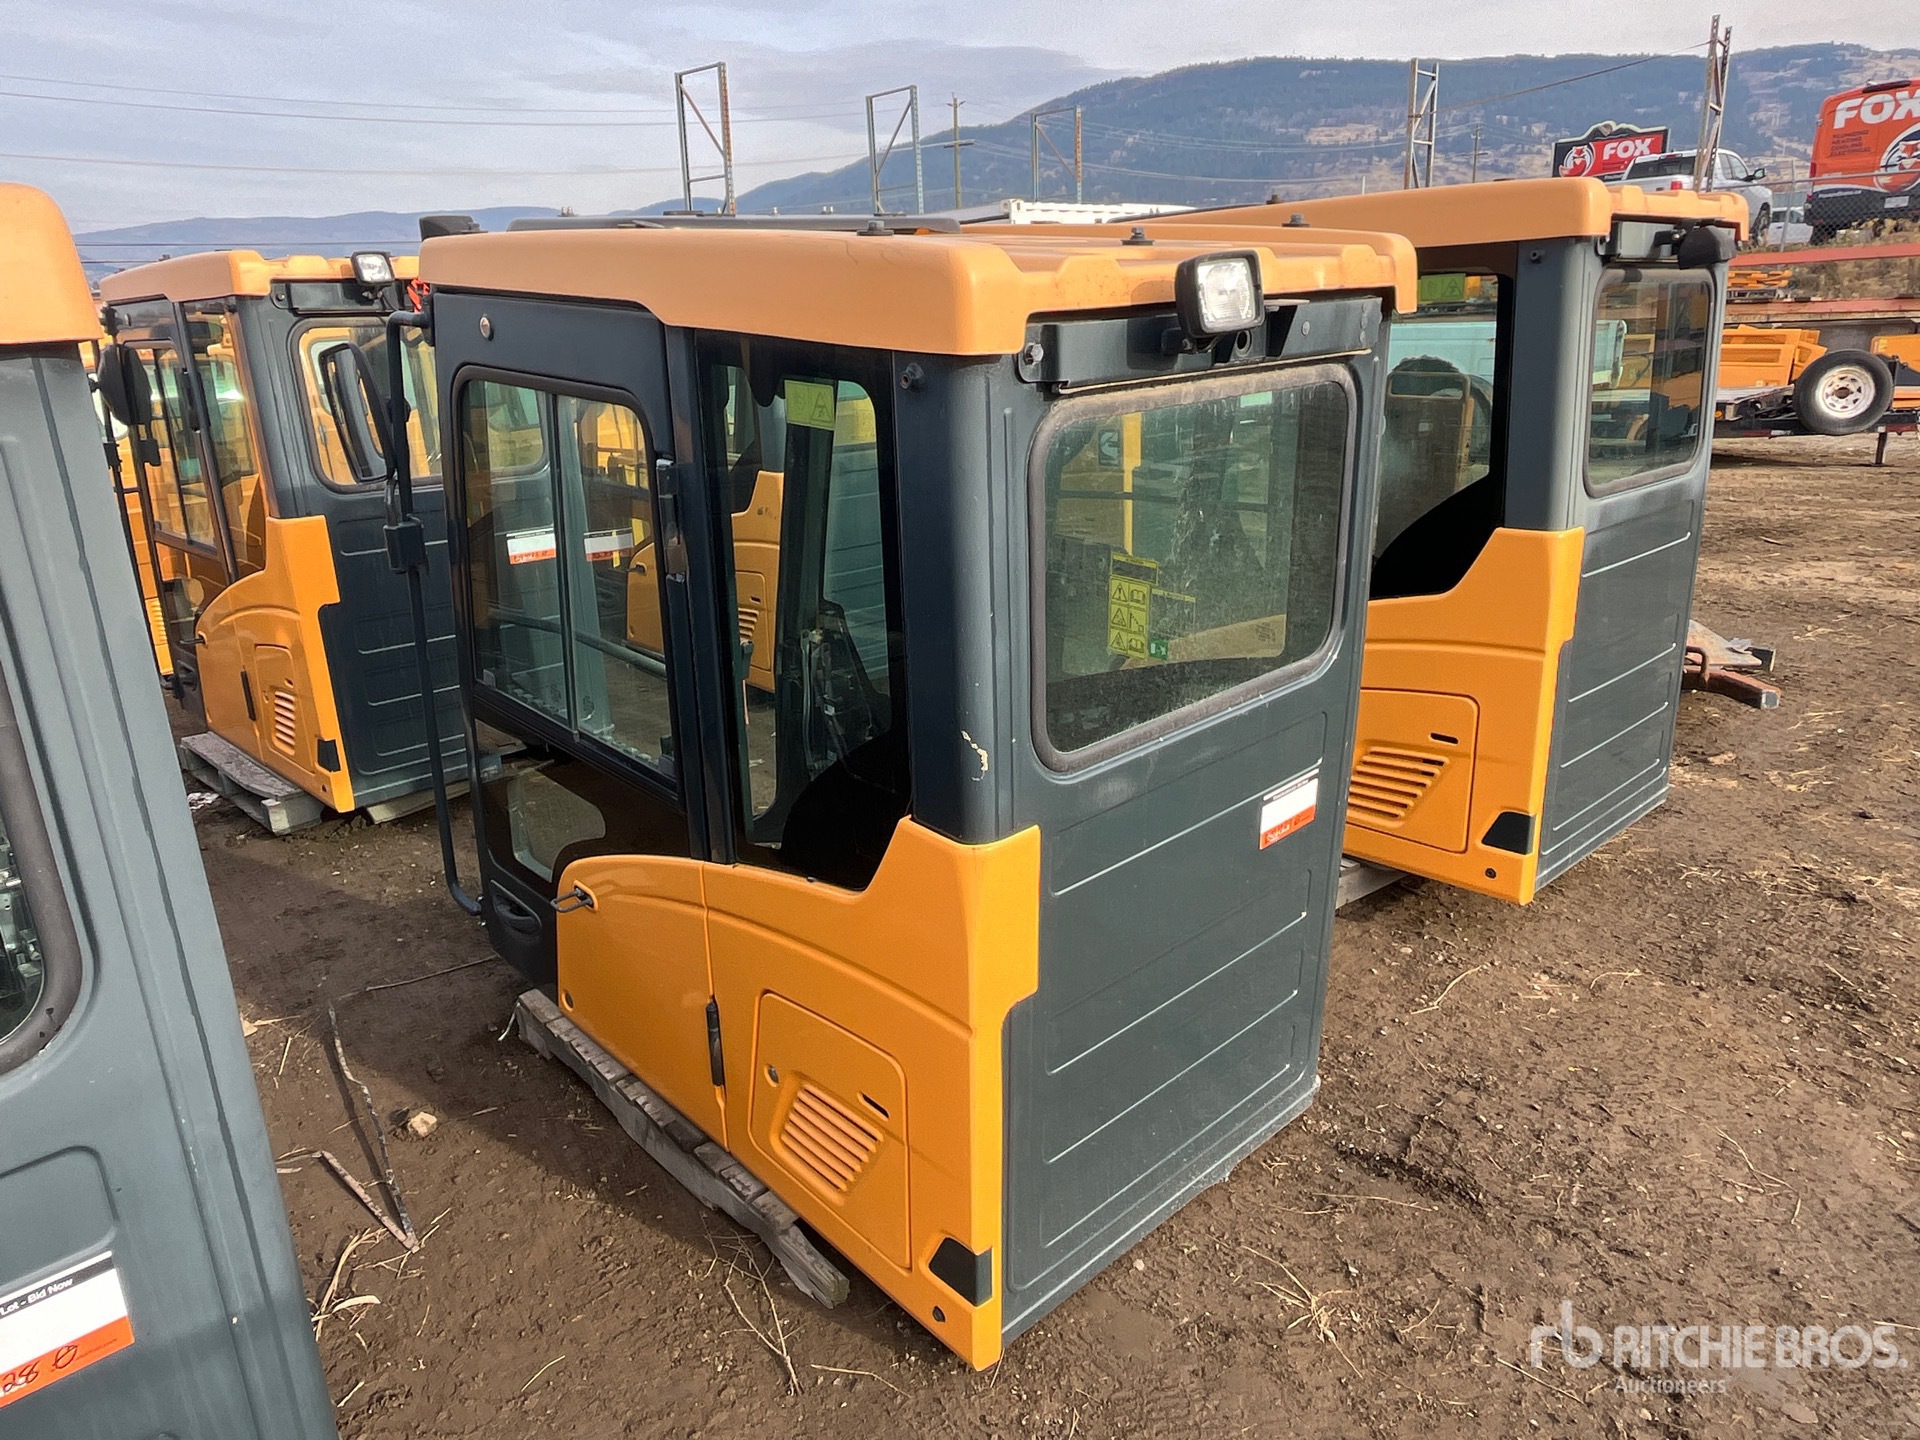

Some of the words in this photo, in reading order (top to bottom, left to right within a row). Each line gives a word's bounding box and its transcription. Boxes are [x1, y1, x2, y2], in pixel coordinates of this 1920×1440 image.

[1833, 89, 1920, 129] FOX
[1602, 138, 1652, 160] FOX
[27, 1288, 47, 1304] Bid
[47, 1278, 74, 1295] Now
